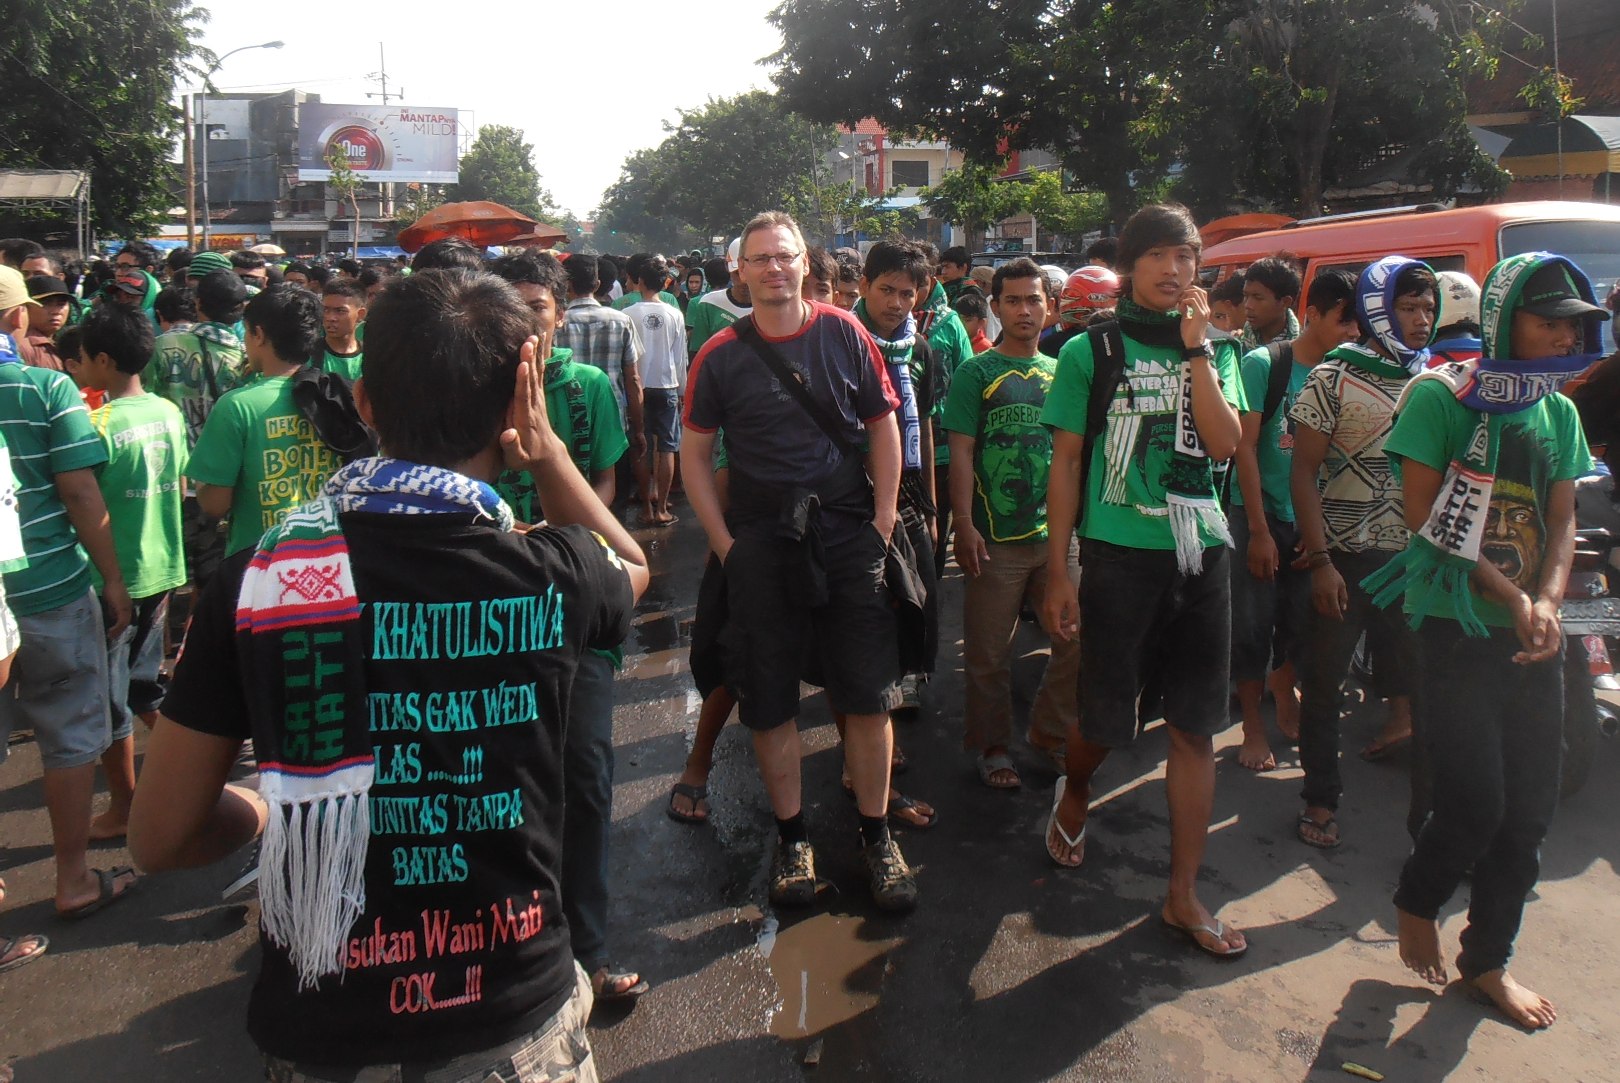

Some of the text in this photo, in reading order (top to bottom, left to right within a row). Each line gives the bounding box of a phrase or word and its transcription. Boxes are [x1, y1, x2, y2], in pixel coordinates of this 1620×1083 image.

[265, 415, 319, 440] NEKA
[990, 405, 1040, 428] PERSEBA
[1151, 423, 1175, 435] PERSE
[372, 582, 564, 660] KHATULISTIWA
[313, 631, 345, 761] HATI
[368, 680, 540, 733] ITAS GAK WEDI
[373, 742, 422, 785] LAS
[369, 788, 524, 836] UNITAS TANPA
[392, 843, 469, 886] BATAS
[345, 889, 545, 969] sukan Wani Mati
